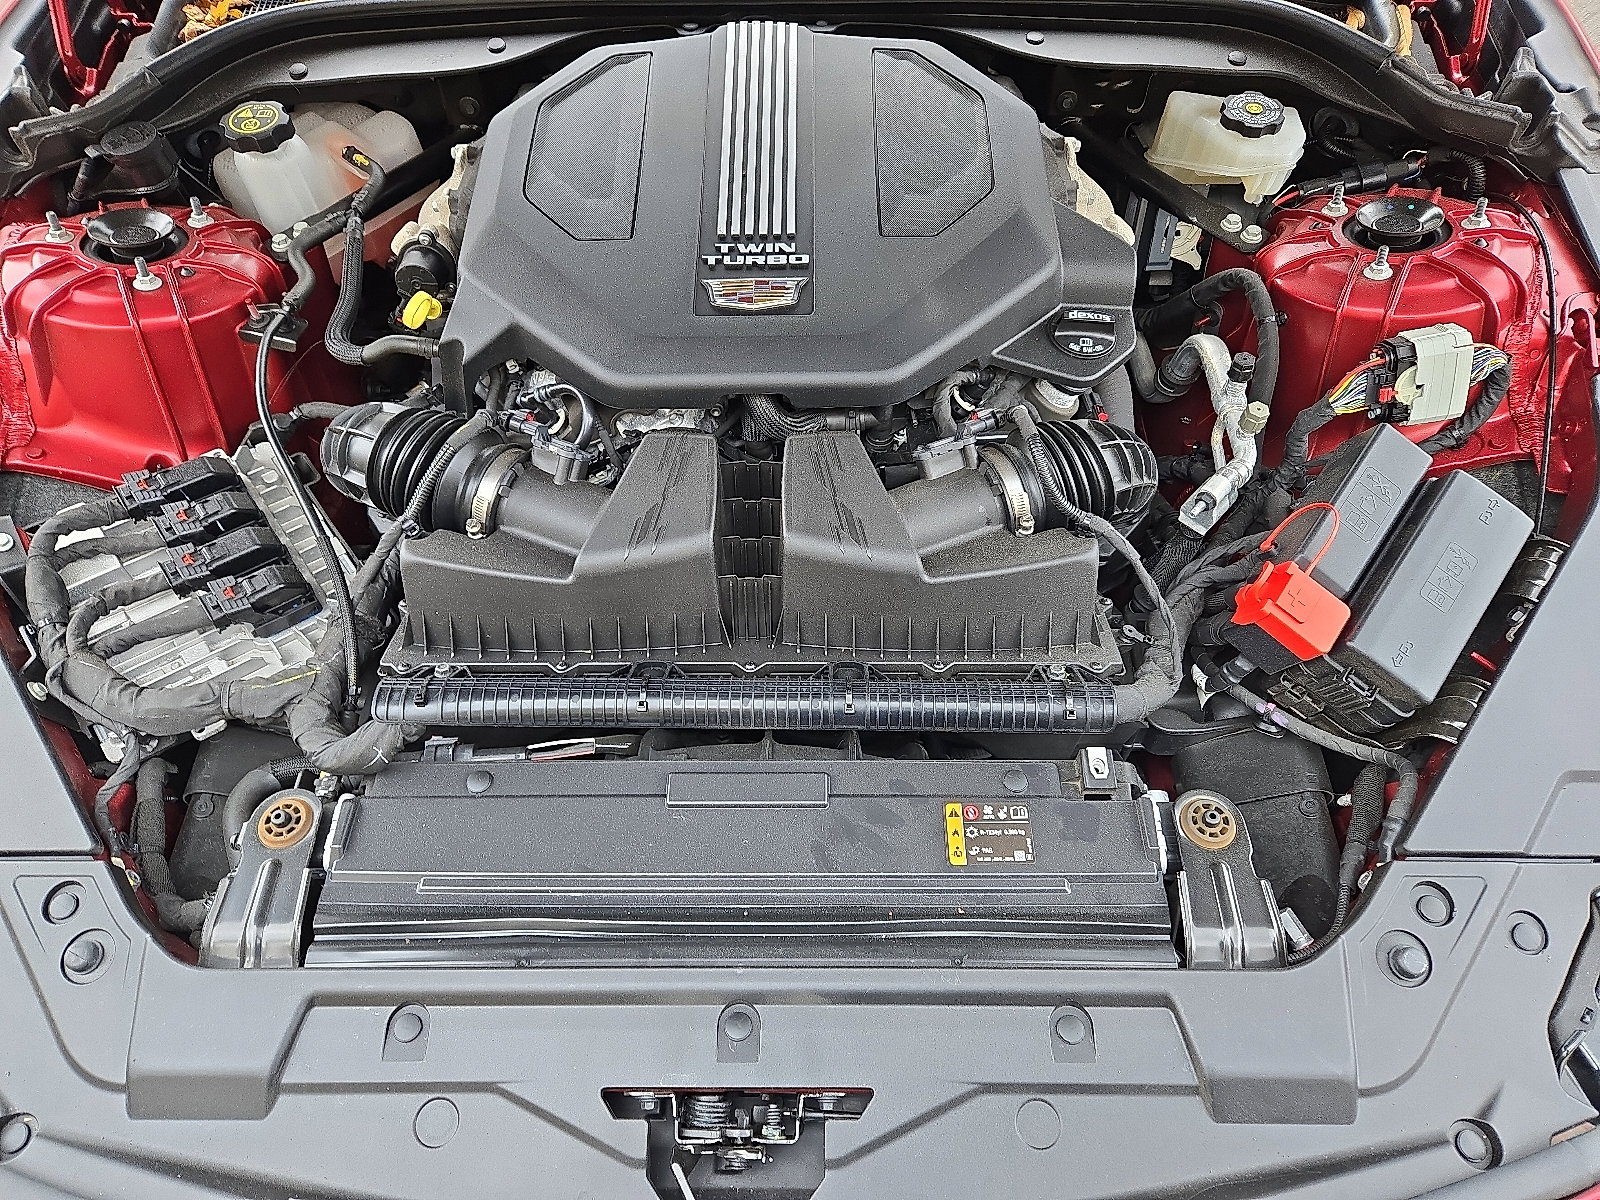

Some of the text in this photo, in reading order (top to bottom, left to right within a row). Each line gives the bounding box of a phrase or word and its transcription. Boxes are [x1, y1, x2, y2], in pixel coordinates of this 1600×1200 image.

[714, 242, 796, 253] TWIN
[701, 254, 810, 266] TURBO
[1068, 309, 1112, 322] dexos
